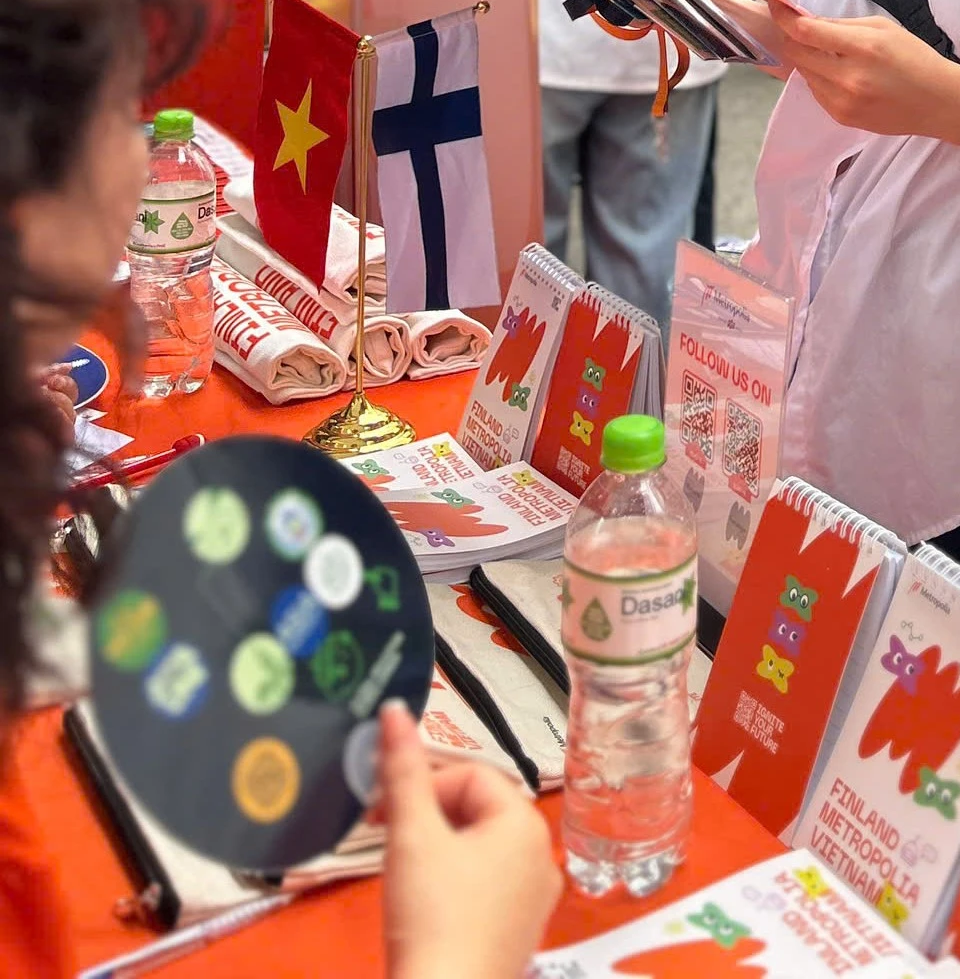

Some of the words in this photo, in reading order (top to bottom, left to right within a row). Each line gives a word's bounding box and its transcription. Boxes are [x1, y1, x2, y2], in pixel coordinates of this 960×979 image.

[255, 265, 339, 340] FINLAND
[680, 332, 730, 379] FOLLOW
[732, 364, 749, 392] US
[752, 379, 772, 407] ON
[465, 416, 513, 465] METROPOLIA
[470, 399, 504, 437] FINLAND
[497, 474, 564, 522] METROPOLIA
[498, 491, 546, 528] FINLAND
[750, 724, 779, 755] FUTURE
[754, 713, 774, 737] YOUR
[756, 703, 785, 734] IGNITE
[829, 777, 900, 851] FINLAND
[810, 825, 884, 905] VIETNAM
[818, 800, 921, 908] METROPOLIA
